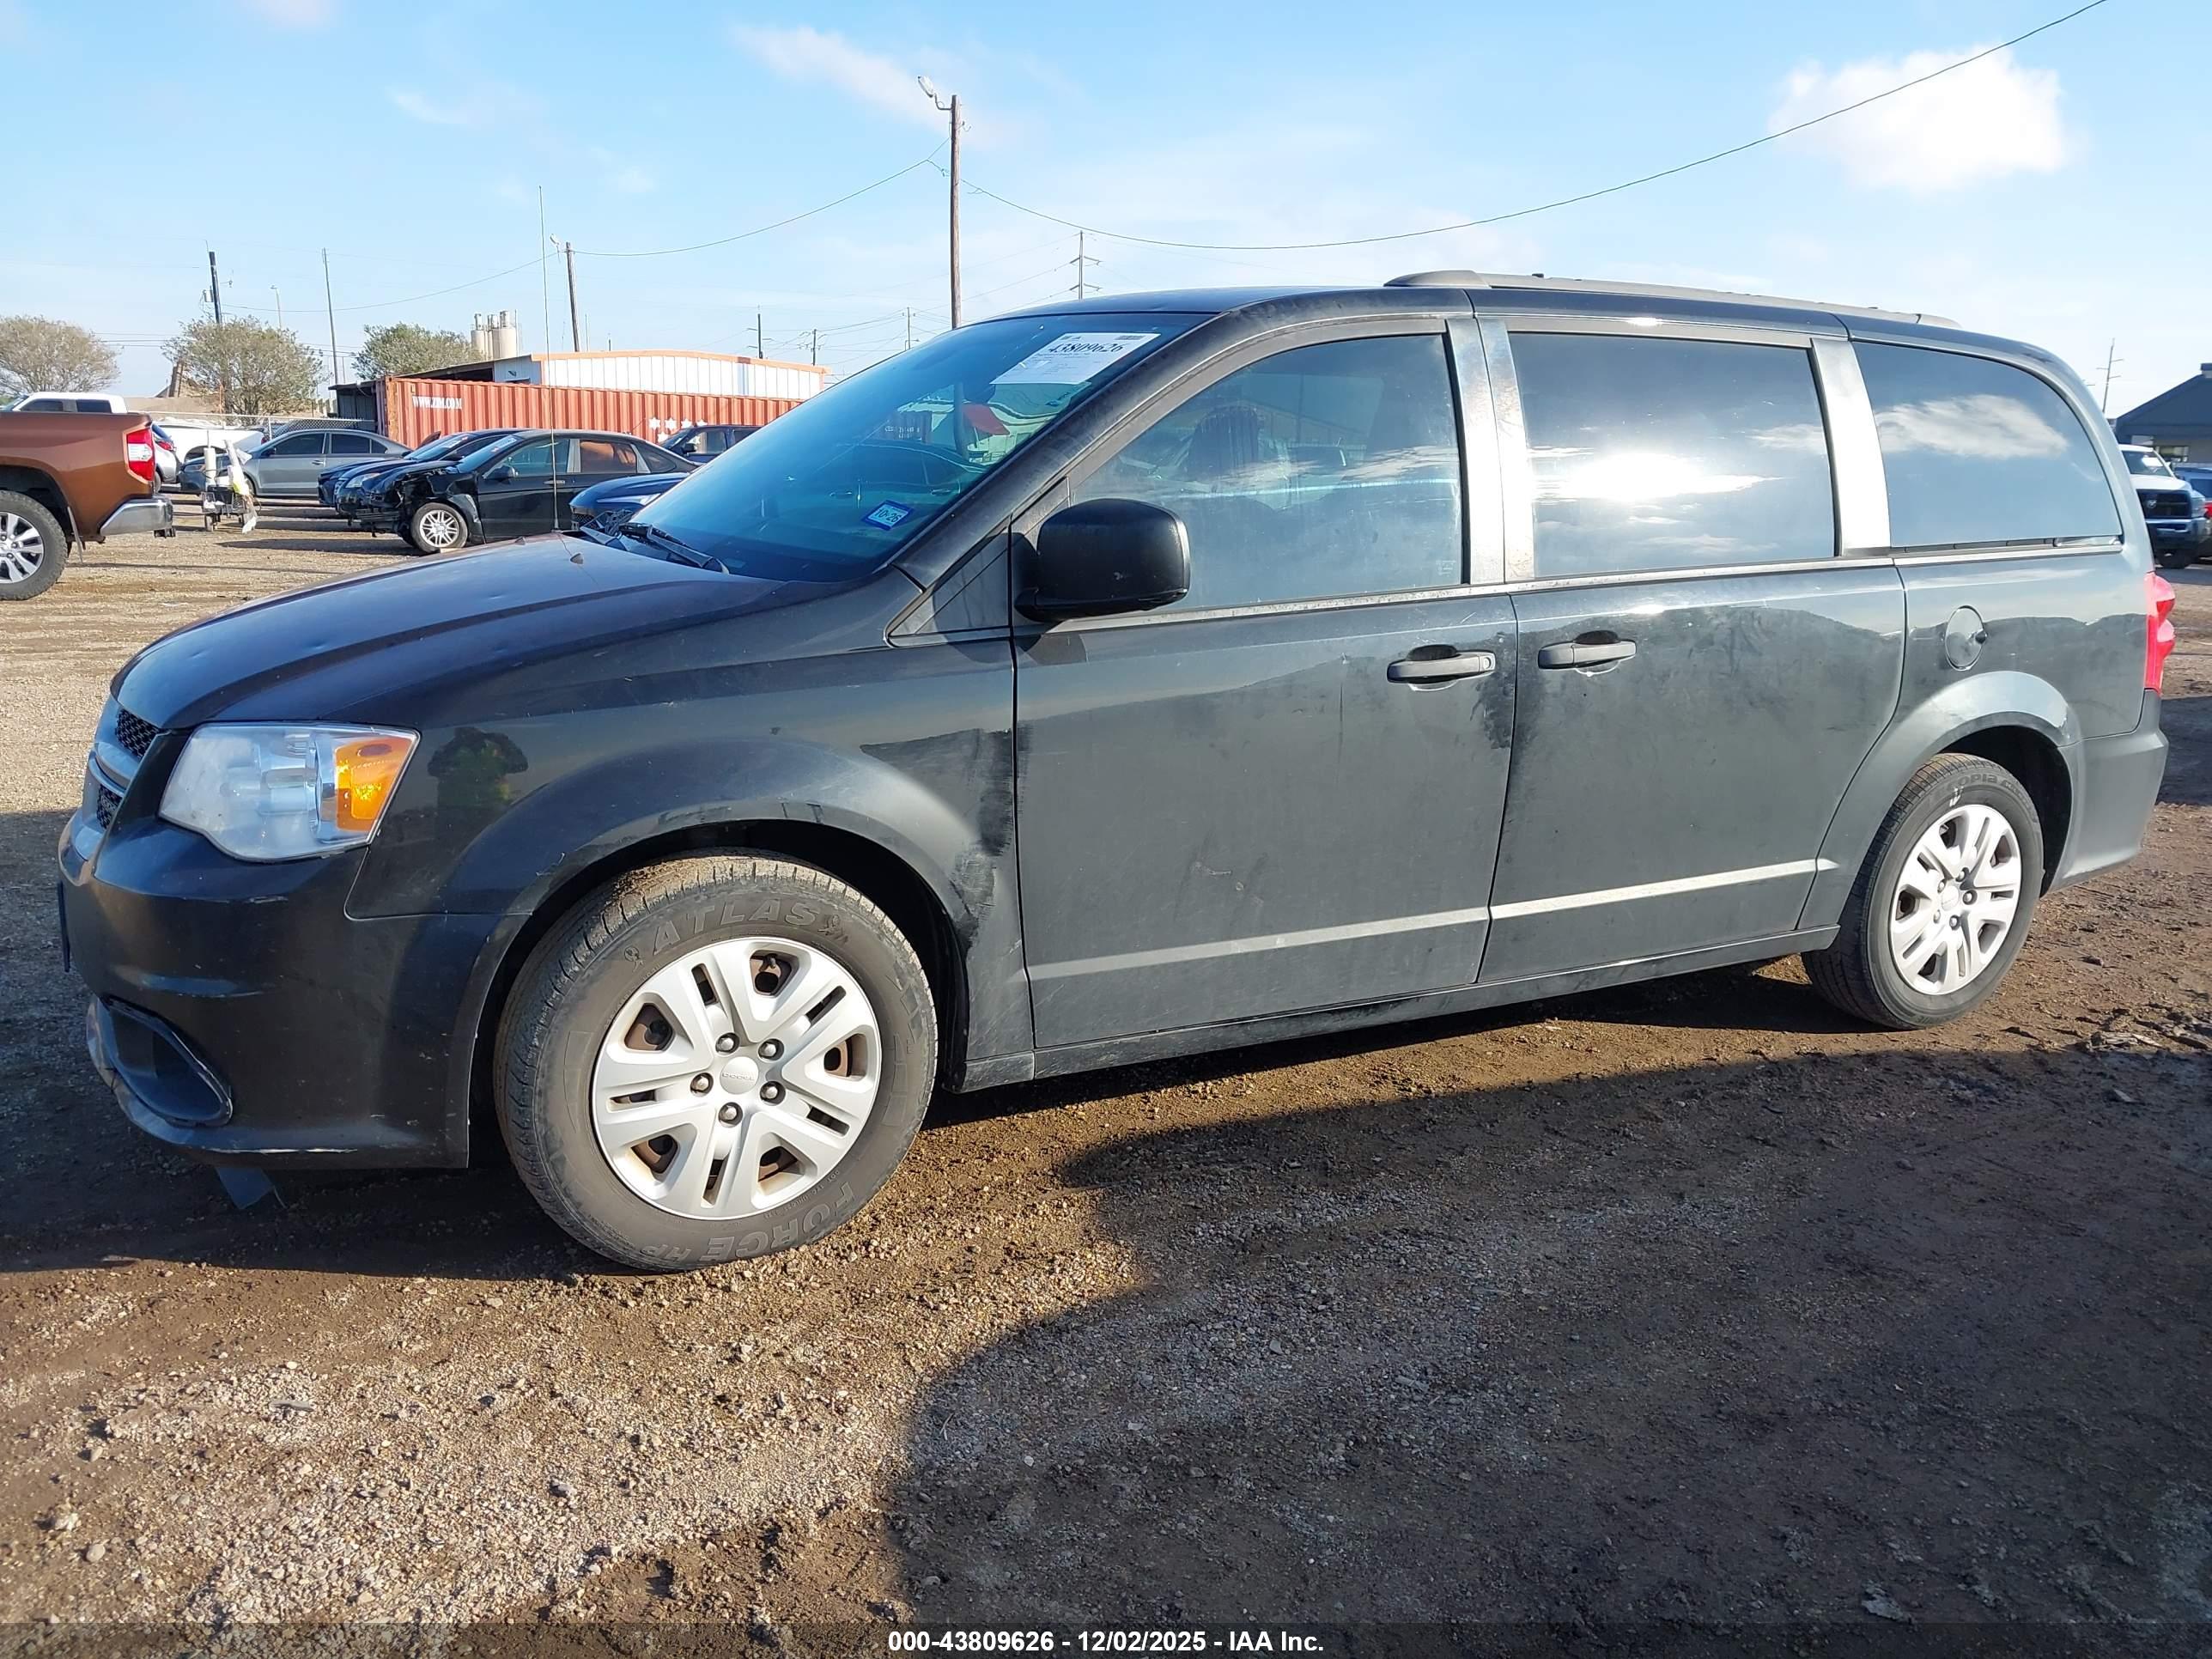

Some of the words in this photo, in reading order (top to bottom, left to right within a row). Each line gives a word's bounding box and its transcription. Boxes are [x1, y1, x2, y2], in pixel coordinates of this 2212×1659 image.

[1048, 343, 1126, 353] 43809626
[653, 901, 819, 956] ATLAS
[698, 1181, 857, 1262] FORCE
